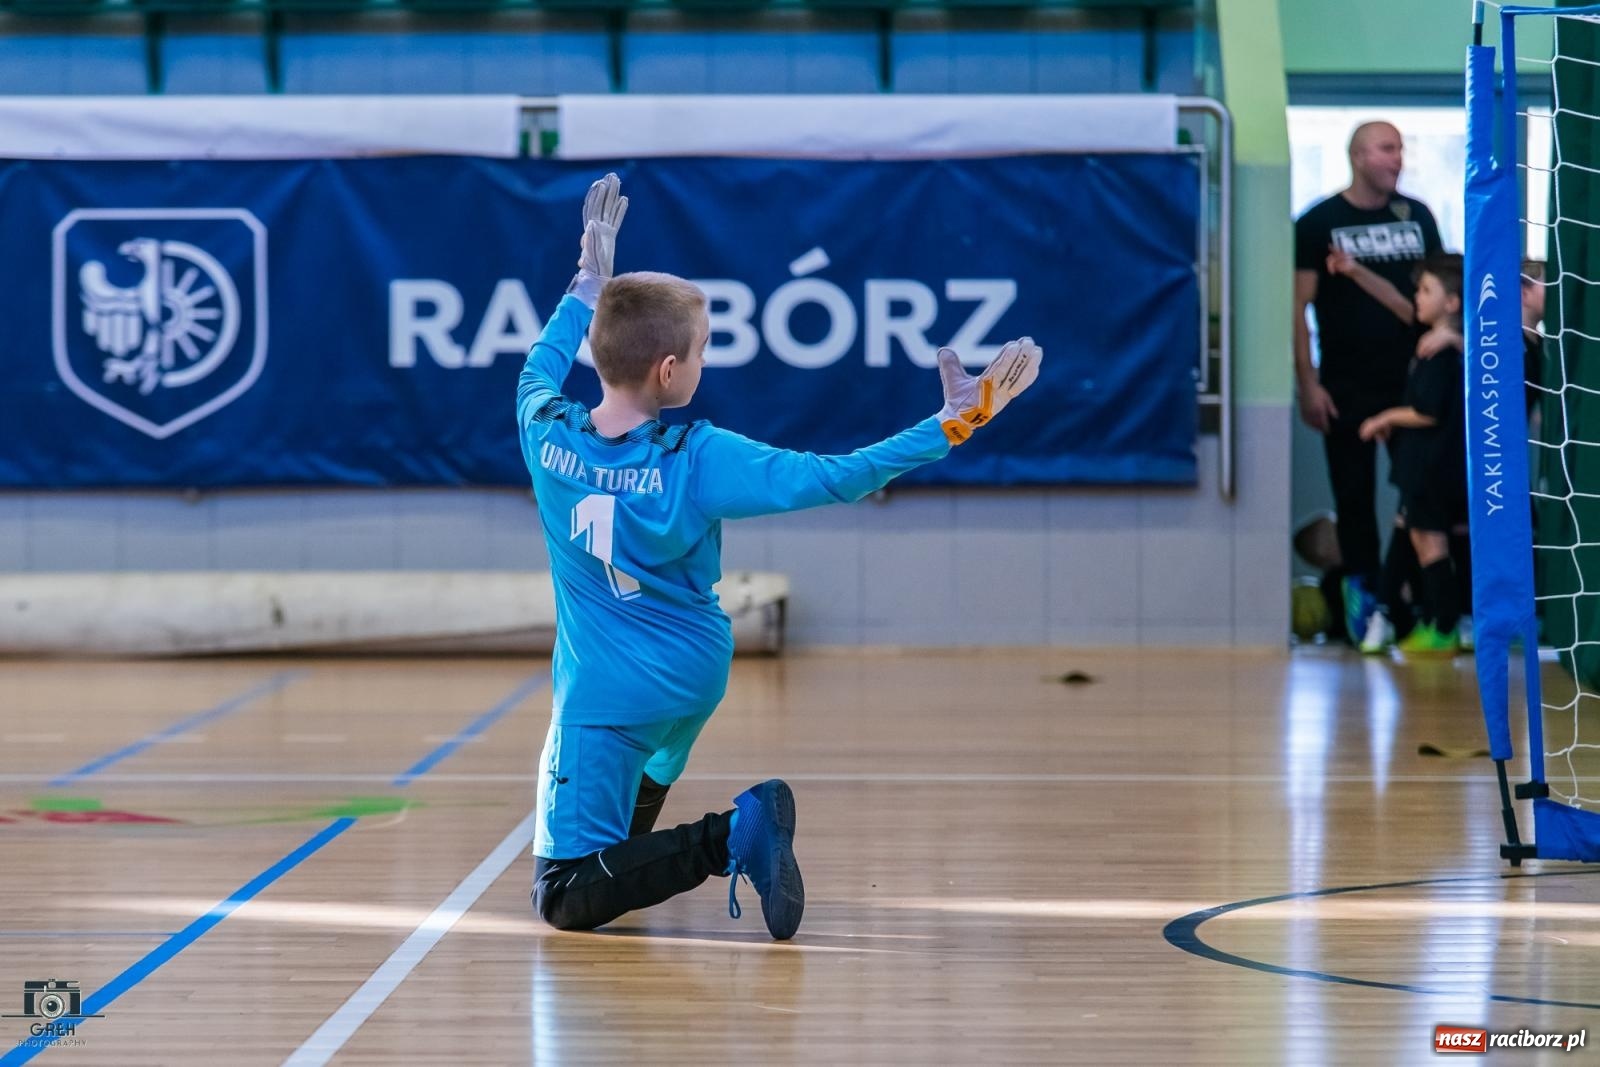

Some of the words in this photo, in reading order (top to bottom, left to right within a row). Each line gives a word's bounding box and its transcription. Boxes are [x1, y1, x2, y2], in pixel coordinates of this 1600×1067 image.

[388, 247, 1017, 369] RABÓRZ
[540, 441, 587, 482] UNIA
[592, 467, 663, 494] TURZA
[1479, 316, 1504, 516] YAKIMASPORT
[569, 493, 642, 601] 1
